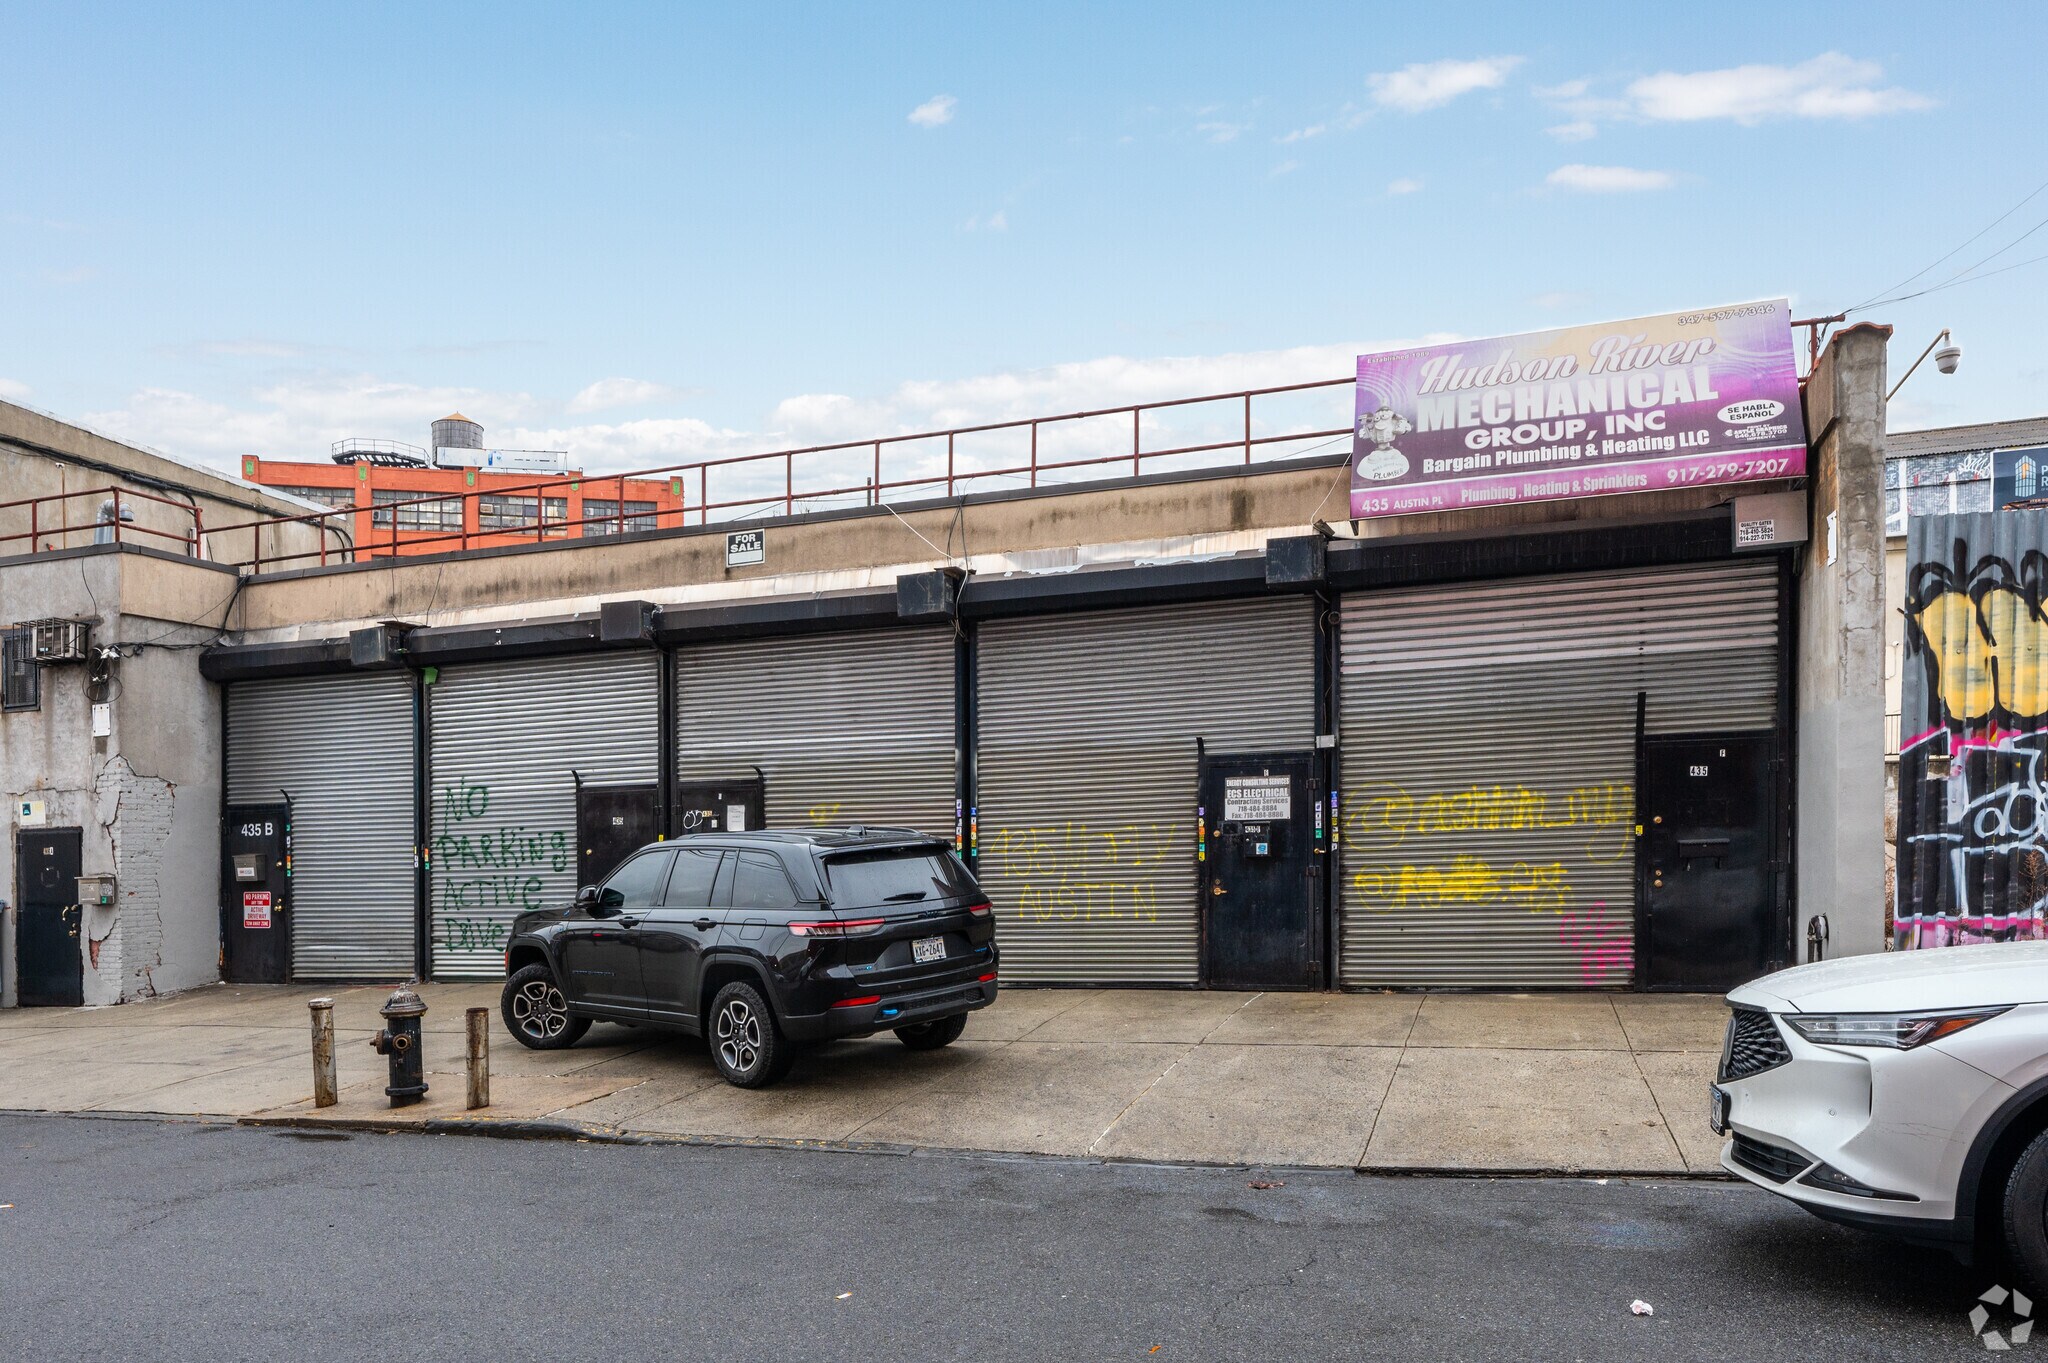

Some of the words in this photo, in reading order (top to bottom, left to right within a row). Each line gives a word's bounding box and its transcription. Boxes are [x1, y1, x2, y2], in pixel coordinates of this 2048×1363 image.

[1677, 304, 1776, 326] 347-597-7346
[1367, 353, 1409, 364] Established
[1416, 346, 1579, 396] Hudson
[1588, 332, 1717, 375] River
[1416, 365, 1719, 433] MECHANICAL
[1727, 406, 1740, 414] SE
[1742, 402, 1776, 412] HABLA
[1729, 410, 1775, 421] ESPAÑOL
[1464, 418, 1598, 450] GROUP,
[1605, 410, 1667, 436] INC
[1423, 453, 1492, 474] Bargain
[1495, 444, 1582, 466] Plumbing
[1584, 443, 1599, 457] &
[1602, 435, 1676, 456] Heating
[1679, 429, 1711, 447] LLC
[1667, 458, 1790, 484] 917-279-7207
[1523, 480, 1571, 498] Heating
[1572, 480, 1582, 493] &
[1583, 473, 1648, 492] Sprinklers
[1361, 497, 1389, 512] 435
[1393, 498, 1429, 510] AUSTIN
[1431, 496, 1443, 506] PL
[735, 533, 756, 544] FOR
[730, 541, 761, 553] SALE
[1690, 766, 1708, 776] 435
[1227, 789, 1242, 798] ECS
[1243, 787, 1289, 798] ELECTRICAL
[1227, 798, 1262, 806] Contracting
[1262, 797, 1289, 805] Services
[241, 823, 262, 837] 435
[264, 822, 274, 836] B
[245, 893, 252, 901] NO
[1017, 883, 1158, 924] AUSTIN
